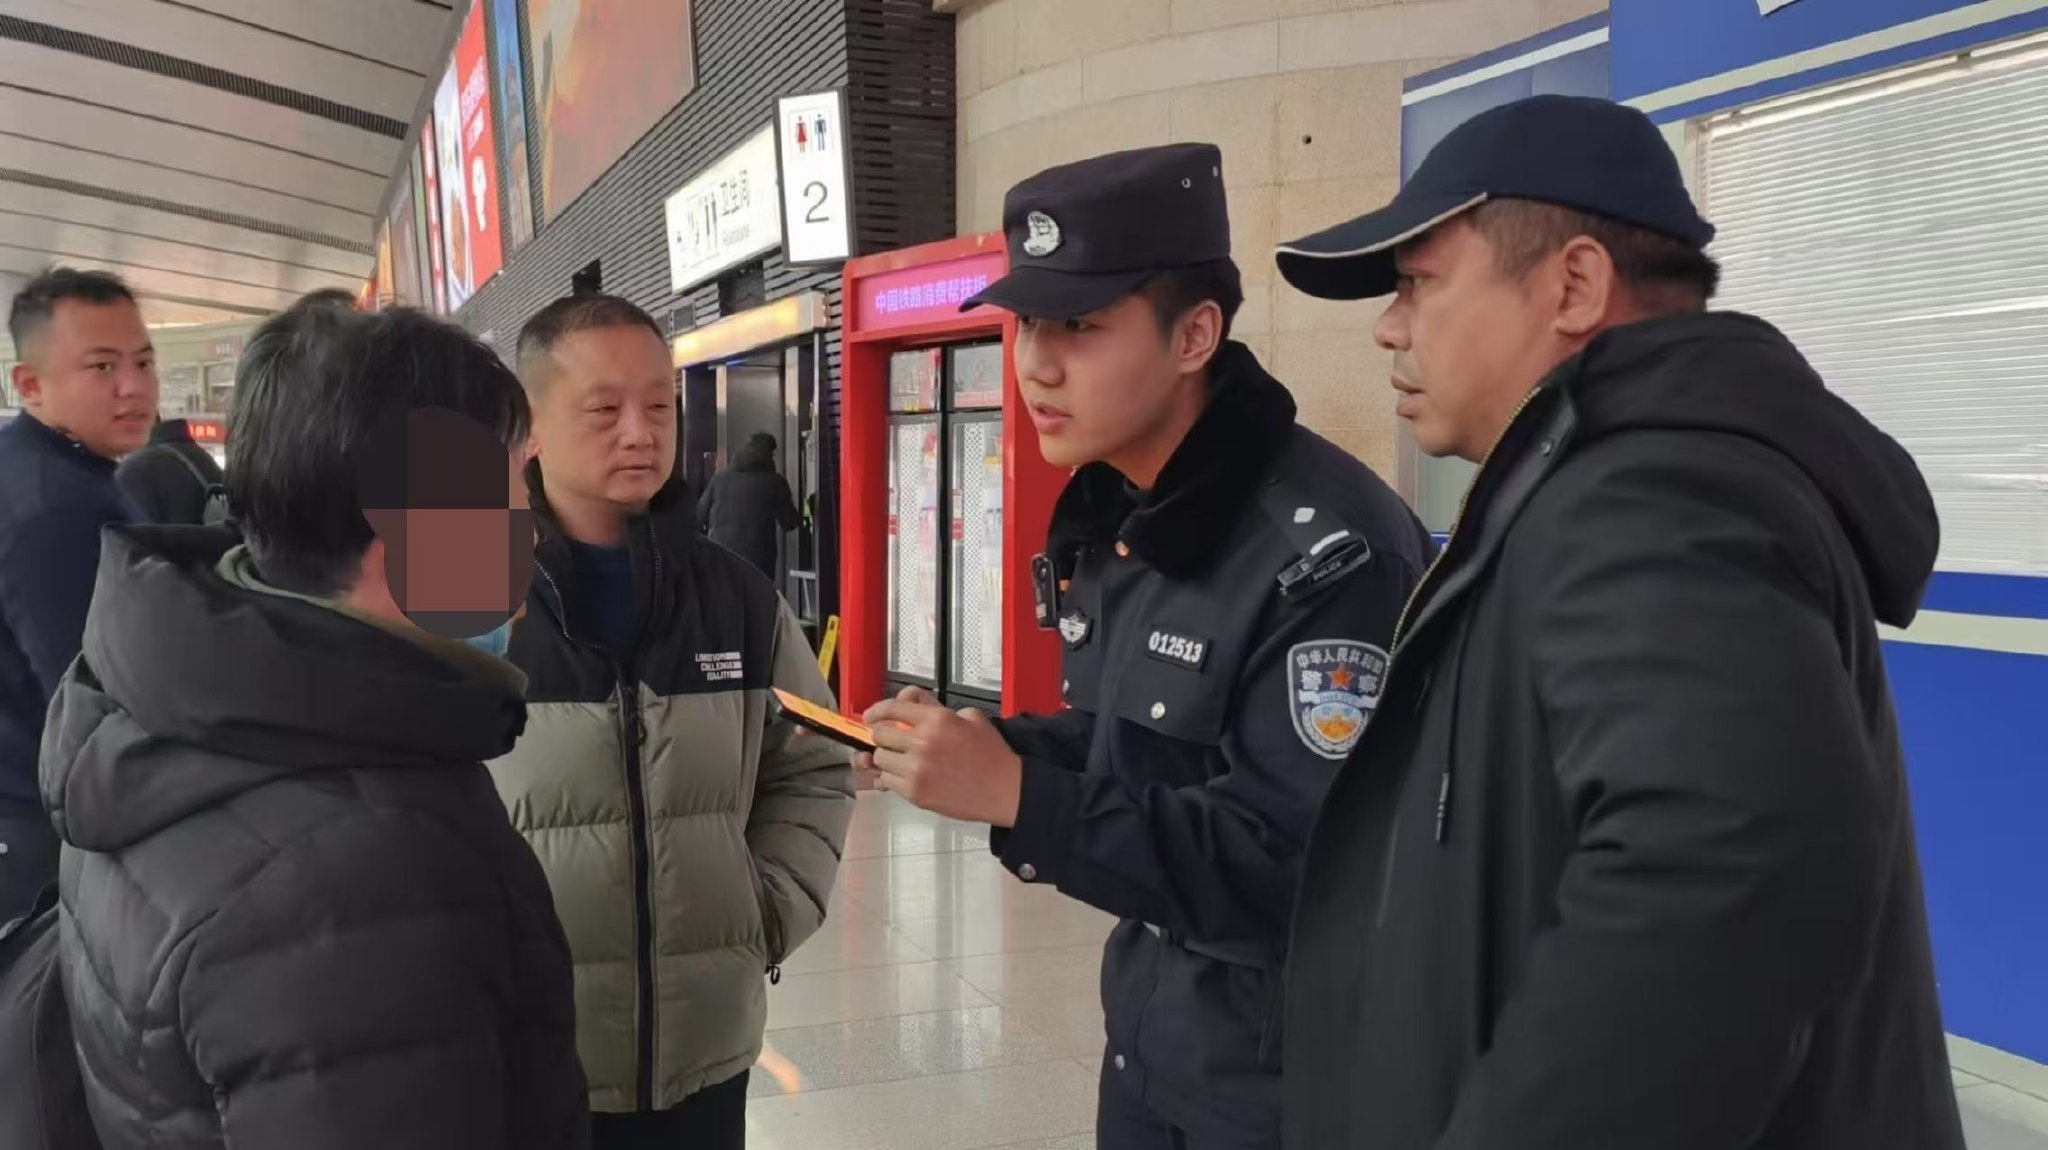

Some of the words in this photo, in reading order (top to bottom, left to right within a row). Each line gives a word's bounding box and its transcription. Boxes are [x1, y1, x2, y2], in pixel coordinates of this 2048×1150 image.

[720, 169, 750, 216] 卫生间
[803, 181, 829, 224] 2
[1148, 632, 1203, 663] 012513
[1297, 647, 1383, 674] 中华人民共和国
